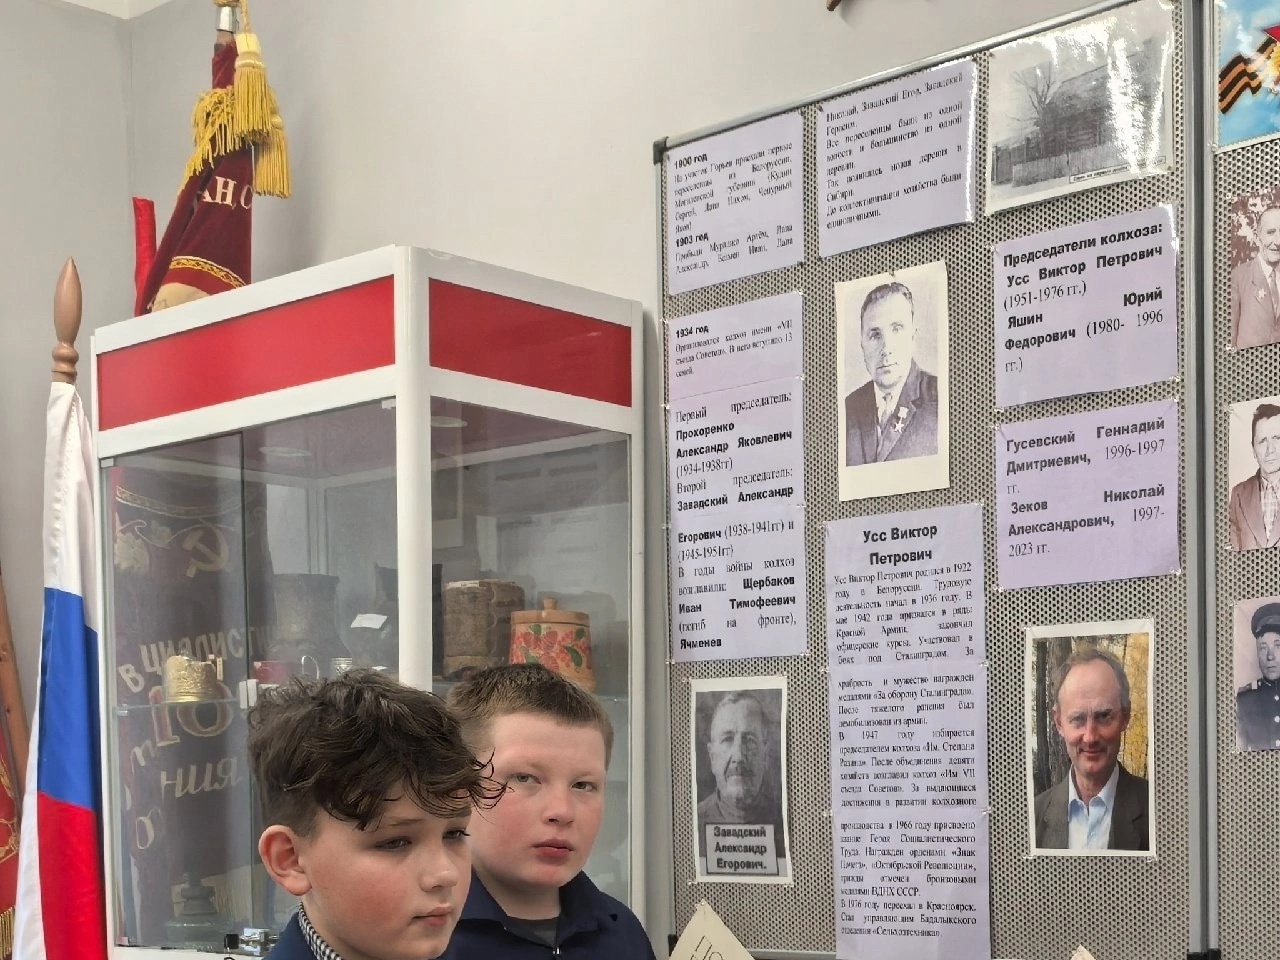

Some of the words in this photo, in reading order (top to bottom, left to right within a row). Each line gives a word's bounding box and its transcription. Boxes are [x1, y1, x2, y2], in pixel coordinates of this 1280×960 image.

[674, 155, 692, 169] 1900
[694, 153, 708, 164] год
[676, 235, 693, 247] 1903
[695, 232, 709, 243] год
[1003, 237, 1096, 267] Председатели
[1100, 223, 1162, 246] колхоза:
[1006, 274, 1029, 287] Усс
[1038, 261, 1086, 280] Виктор
[1096, 245, 1162, 268] Петрович
[1003, 284, 1063, 312] (1951-1976
[1066, 279, 1086, 296] гг.)
[1007, 313, 1042, 329] Яшин
[1123, 285, 1162, 307] Юрий
[676, 326, 693, 338] 1934
[695, 325, 709, 334] год
[1004, 328, 1075, 350] Федорович
[1086, 317, 1124, 339] (1980-
[1137, 308, 1163, 326] 1996
[1005, 356, 1022, 372] гг.)
[730, 392, 791, 414] председатель:
[675, 422, 734, 442] Прохоренко
[1006, 430, 1075, 454] Гусевский
[1096, 416, 1164, 439] Геннадий
[675, 442, 728, 459] Александр
[737, 430, 792, 448] Яковлевич
[1006, 453, 1090, 476] Дмитриевич,
[1105, 438, 1164, 460] 1996-1997
[676, 478, 706, 494] Второй
[732, 467, 792, 487] председатель:
[677, 493, 728, 511] Завадский
[737, 486, 793, 502] Александр
[1010, 500, 1047, 514] Зеков
[1103, 483, 1164, 502] Николай
[1008, 515, 1114, 536] Александрович,
[1133, 505, 1164, 521] 1997-
[677, 530, 721, 544] Егорович
[862, 529, 887, 543] Усс
[890, 524, 937, 540] Виктор
[869, 549, 932, 566] Петрович
[1008, 541, 1032, 557] 2023
[742, 575, 794, 590] Щербаков
[678, 603, 701, 614] Иван
[728, 595, 795, 609] Тимофеевич
[680, 638, 721, 649] Ячменев
[713, 826, 767, 839] Завадский
[714, 841, 767, 856] Александр
[716, 858, 767, 871] Егорович.
